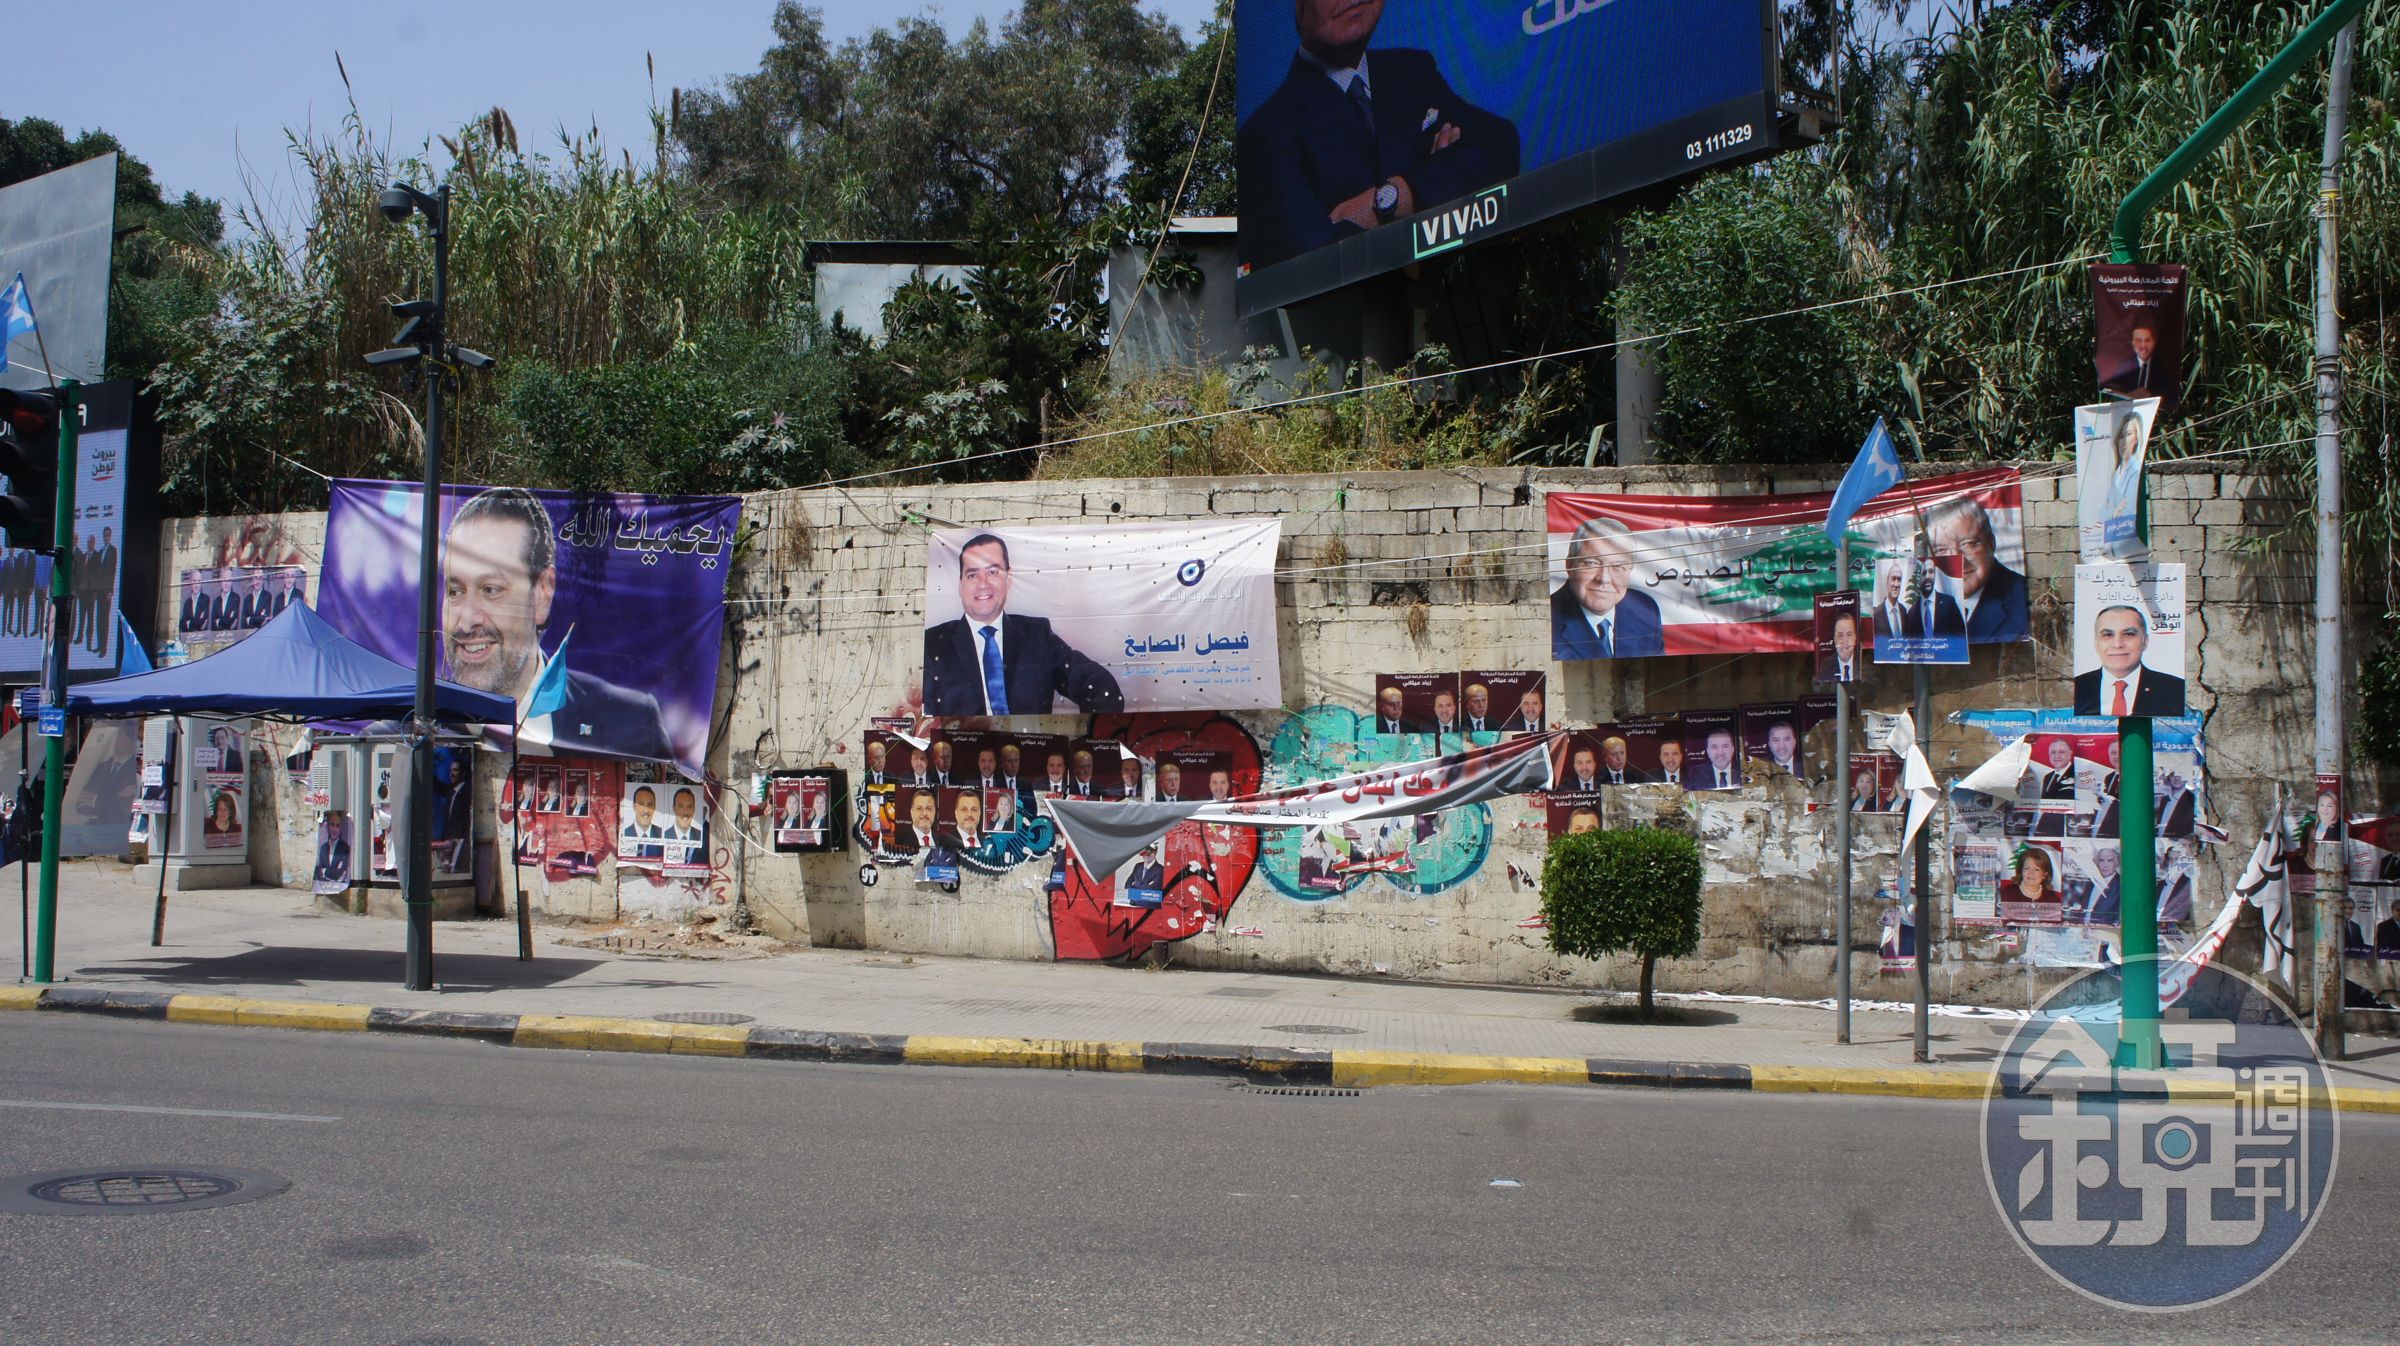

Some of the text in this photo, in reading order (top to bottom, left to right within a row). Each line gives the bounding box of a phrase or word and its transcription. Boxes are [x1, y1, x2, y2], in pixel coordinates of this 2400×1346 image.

[1686, 124, 1752, 160] 03 111329
[1421, 195, 1499, 246] VIVAD
[2098, 274, 2179, 285] لائحة المعارضة البيروتية
[2122, 299, 2145, 309] عيتاني
[92, 448, 116, 461] بيروت
[91, 461, 116, 476] الوطن
[559, 498, 725, 570] يحميك الله
[1644, 556, 1752, 588] الصوص
[1763, 553, 1818, 594] علي
[2128, 570, 2178, 587] مصطفى
[2096, 590, 2175, 603] دائرة بيروت الثانية
[2150, 610, 2181, 621] بيروت
[2150, 621, 2181, 632] الوطن
[1124, 631, 1249, 657] فيصل الصايغ
[1274, 807, 1304, 819] المختار
[1307, 808, 1331, 819] تقدمة
